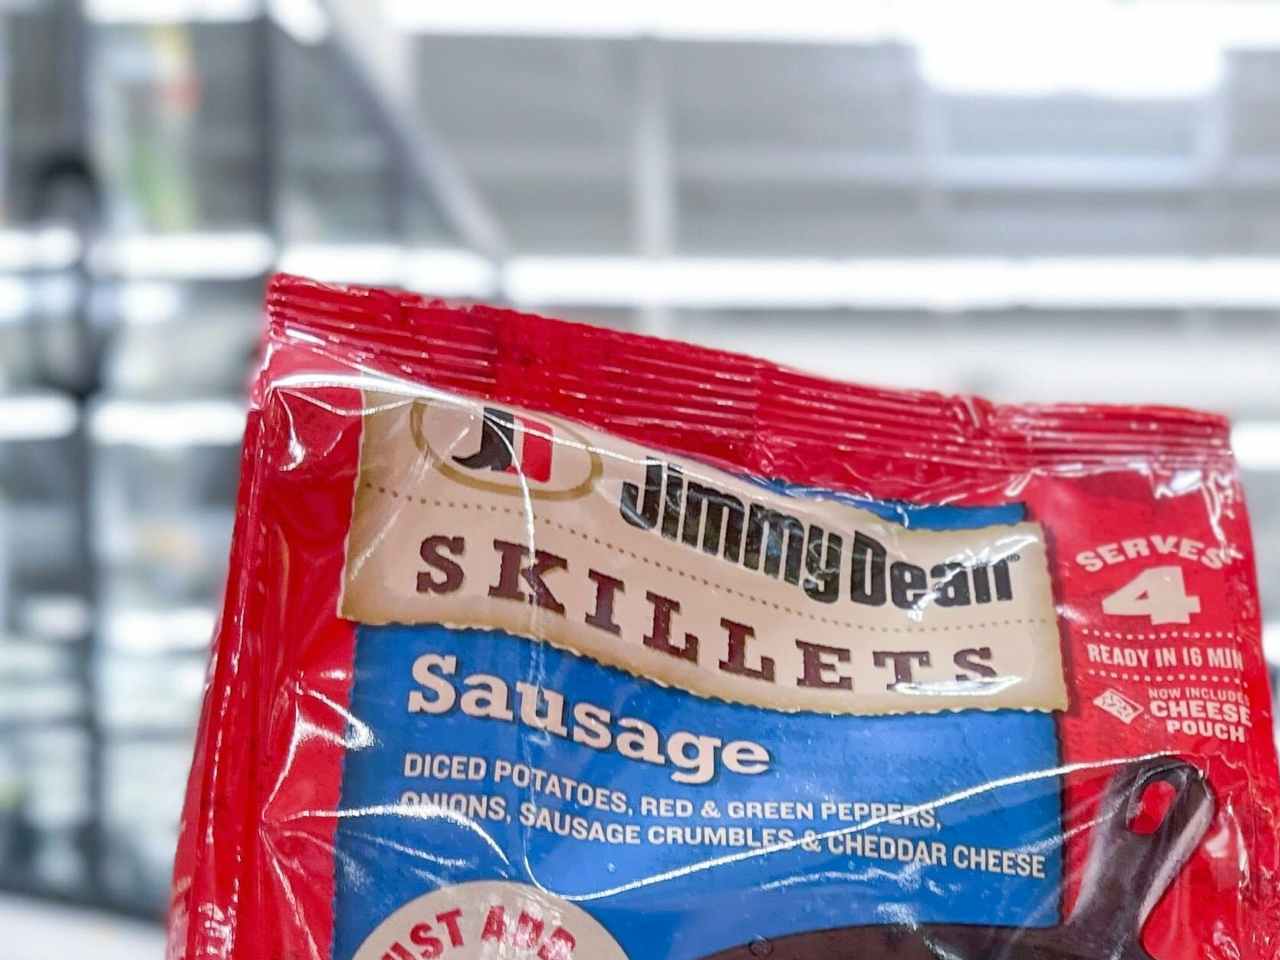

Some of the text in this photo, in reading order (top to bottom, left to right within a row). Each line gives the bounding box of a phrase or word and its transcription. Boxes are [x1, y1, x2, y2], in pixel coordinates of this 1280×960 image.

[620, 455, 843, 604] Jimmy
[1076, 535, 1234, 573] SERVES
[415, 534, 1000, 692] SKILLETS
[1103, 565, 1201, 626] 4
[1087, 643, 1245, 672] READY IN 16 MIN
[407, 653, 771, 784] Sausage
[1148, 687, 1181, 700] NOW
[1150, 700, 1252, 727] CHEESE
[1167, 720, 1246, 744] POUCH
[404, 752, 942, 832] DICED POTATOES, RED & GREEN PEPPERS,
[400, 790, 1046, 879] ONIONS, SAUSAGE CRUMBLES & CHEDDAR CHEESE
